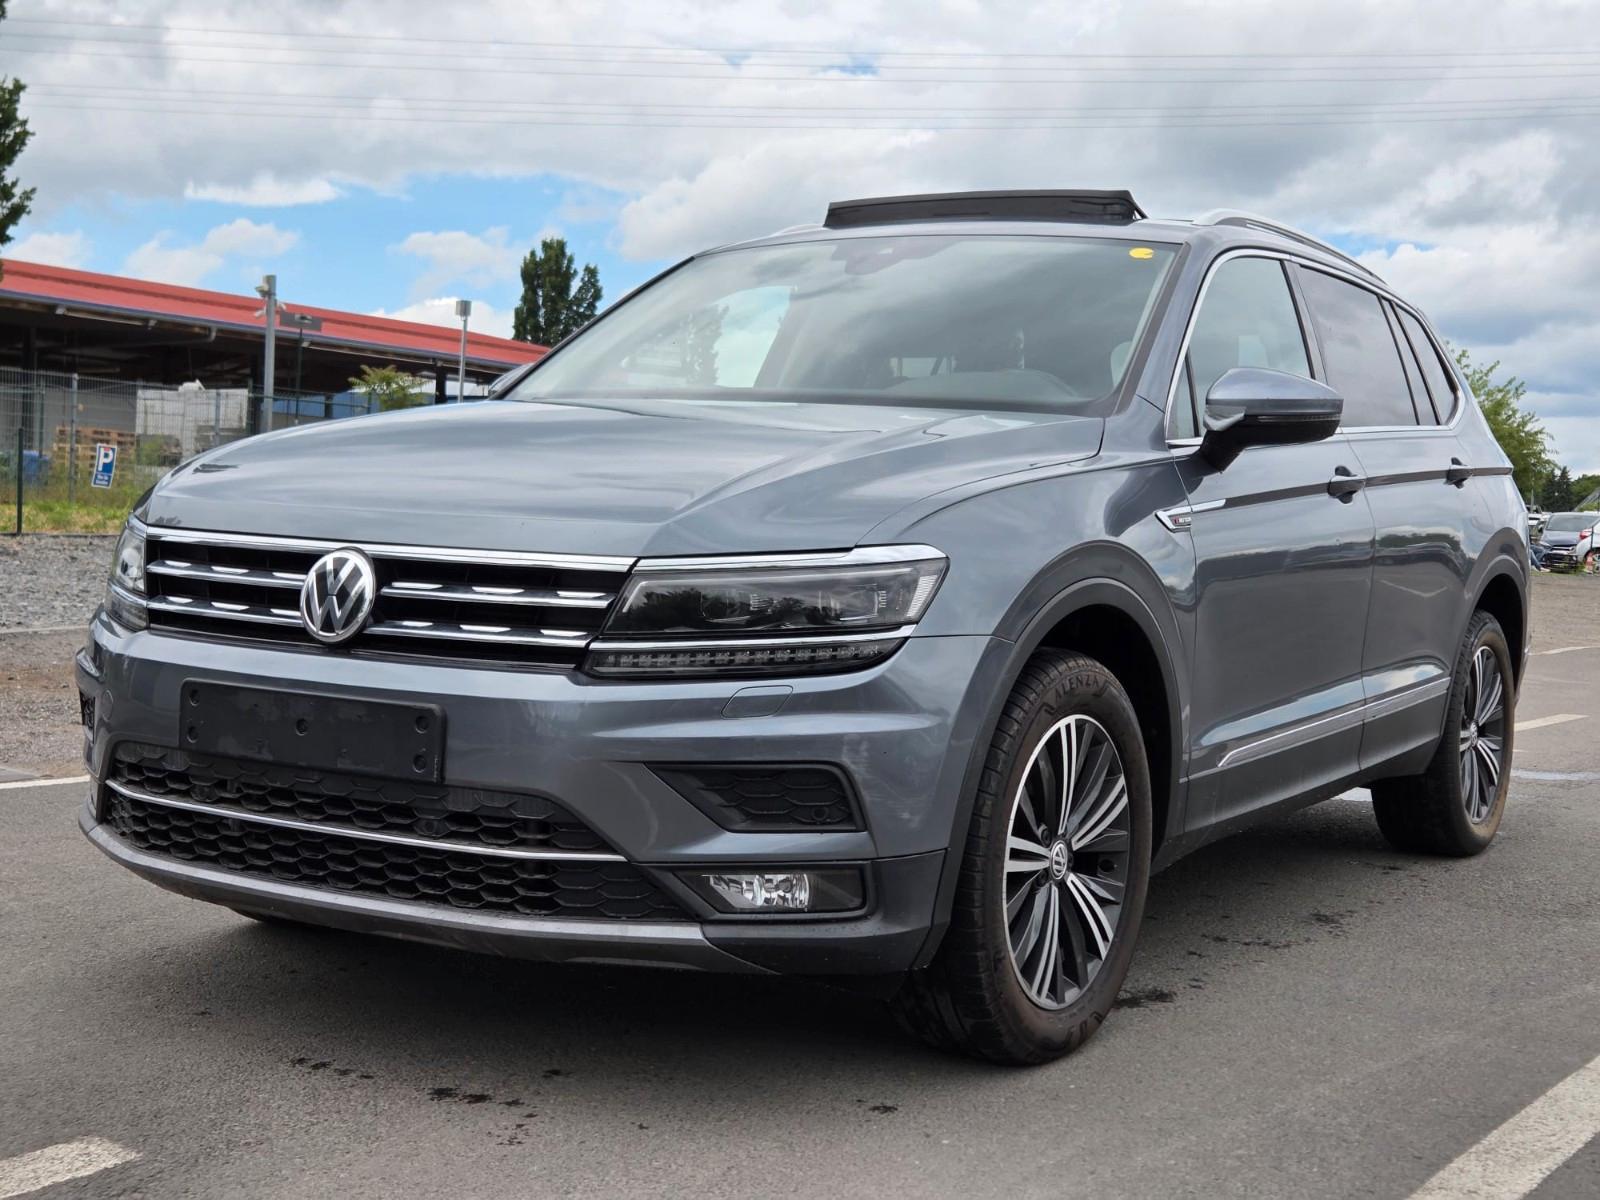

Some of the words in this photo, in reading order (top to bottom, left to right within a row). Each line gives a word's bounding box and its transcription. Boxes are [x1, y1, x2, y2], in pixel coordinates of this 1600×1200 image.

[98, 447, 113, 471] P
[302, 550, 374, 640] VW
[1055, 674, 1100, 702] ALENZA
